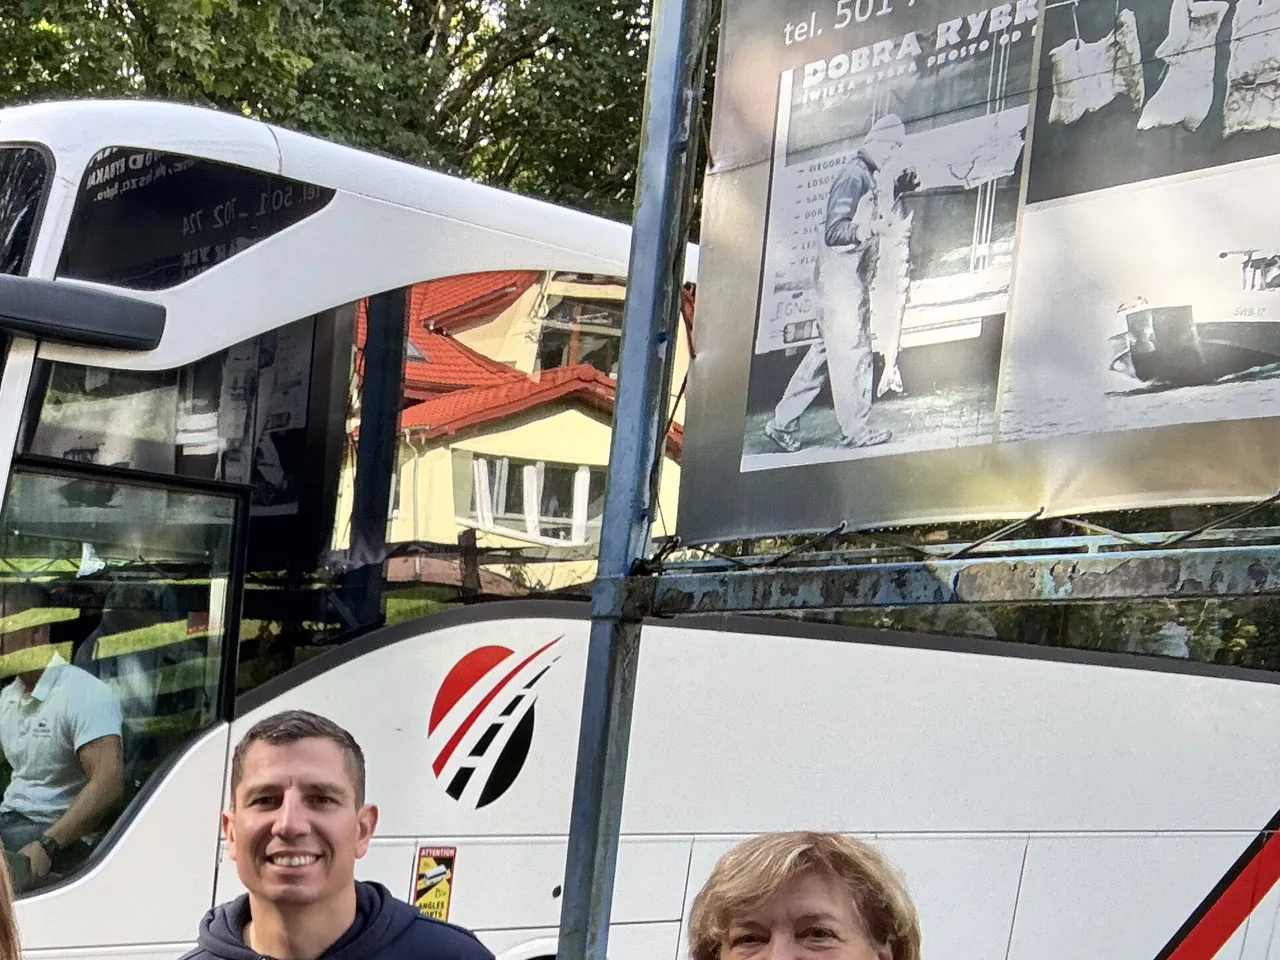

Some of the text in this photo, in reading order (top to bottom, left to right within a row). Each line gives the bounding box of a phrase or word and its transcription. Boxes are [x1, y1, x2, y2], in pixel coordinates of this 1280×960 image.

[783, 11, 823, 46] tel.
[802, 31, 923, 90] DOBRA
[421, 848, 455, 857] ATTENTION
[419, 901, 445, 910] ANGLES
